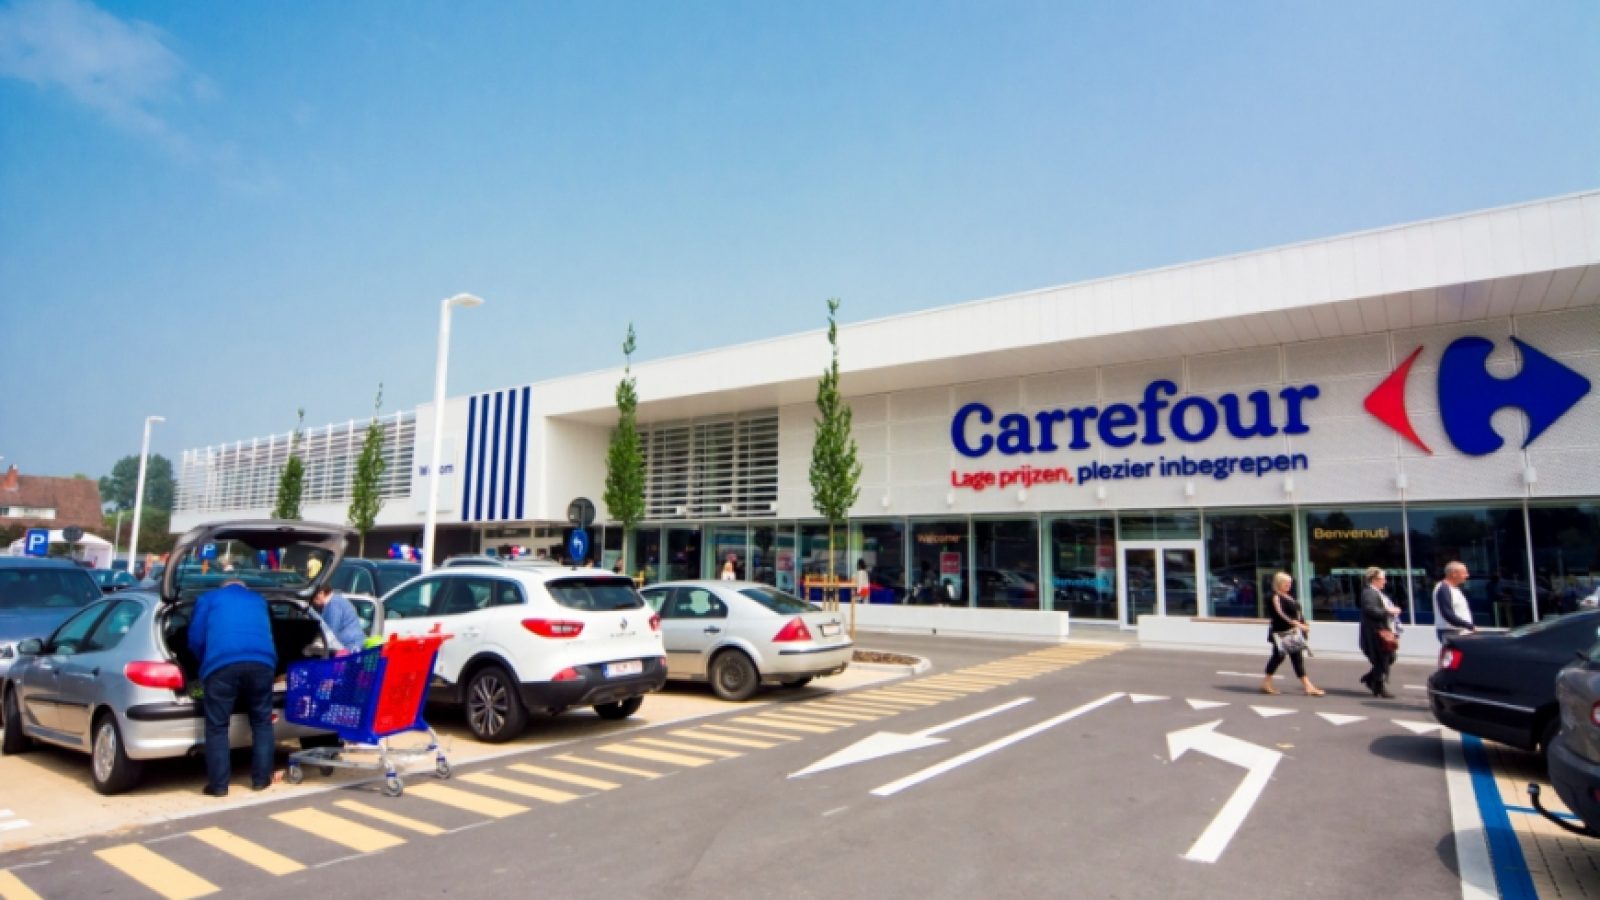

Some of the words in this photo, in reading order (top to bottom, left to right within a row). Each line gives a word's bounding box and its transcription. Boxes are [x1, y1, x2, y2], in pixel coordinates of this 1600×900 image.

[951, 379, 1320, 458] Carrefour
[951, 470, 996, 491] Lage
[999, 464, 1074, 489] prijzen,
[1077, 458, 1155, 486] plezier
[1159, 452, 1309, 480] inbegrepen
[29, 533, 45, 551] P
[1314, 526, 1389, 540] Benvenuti
[202, 543, 216, 556] P
